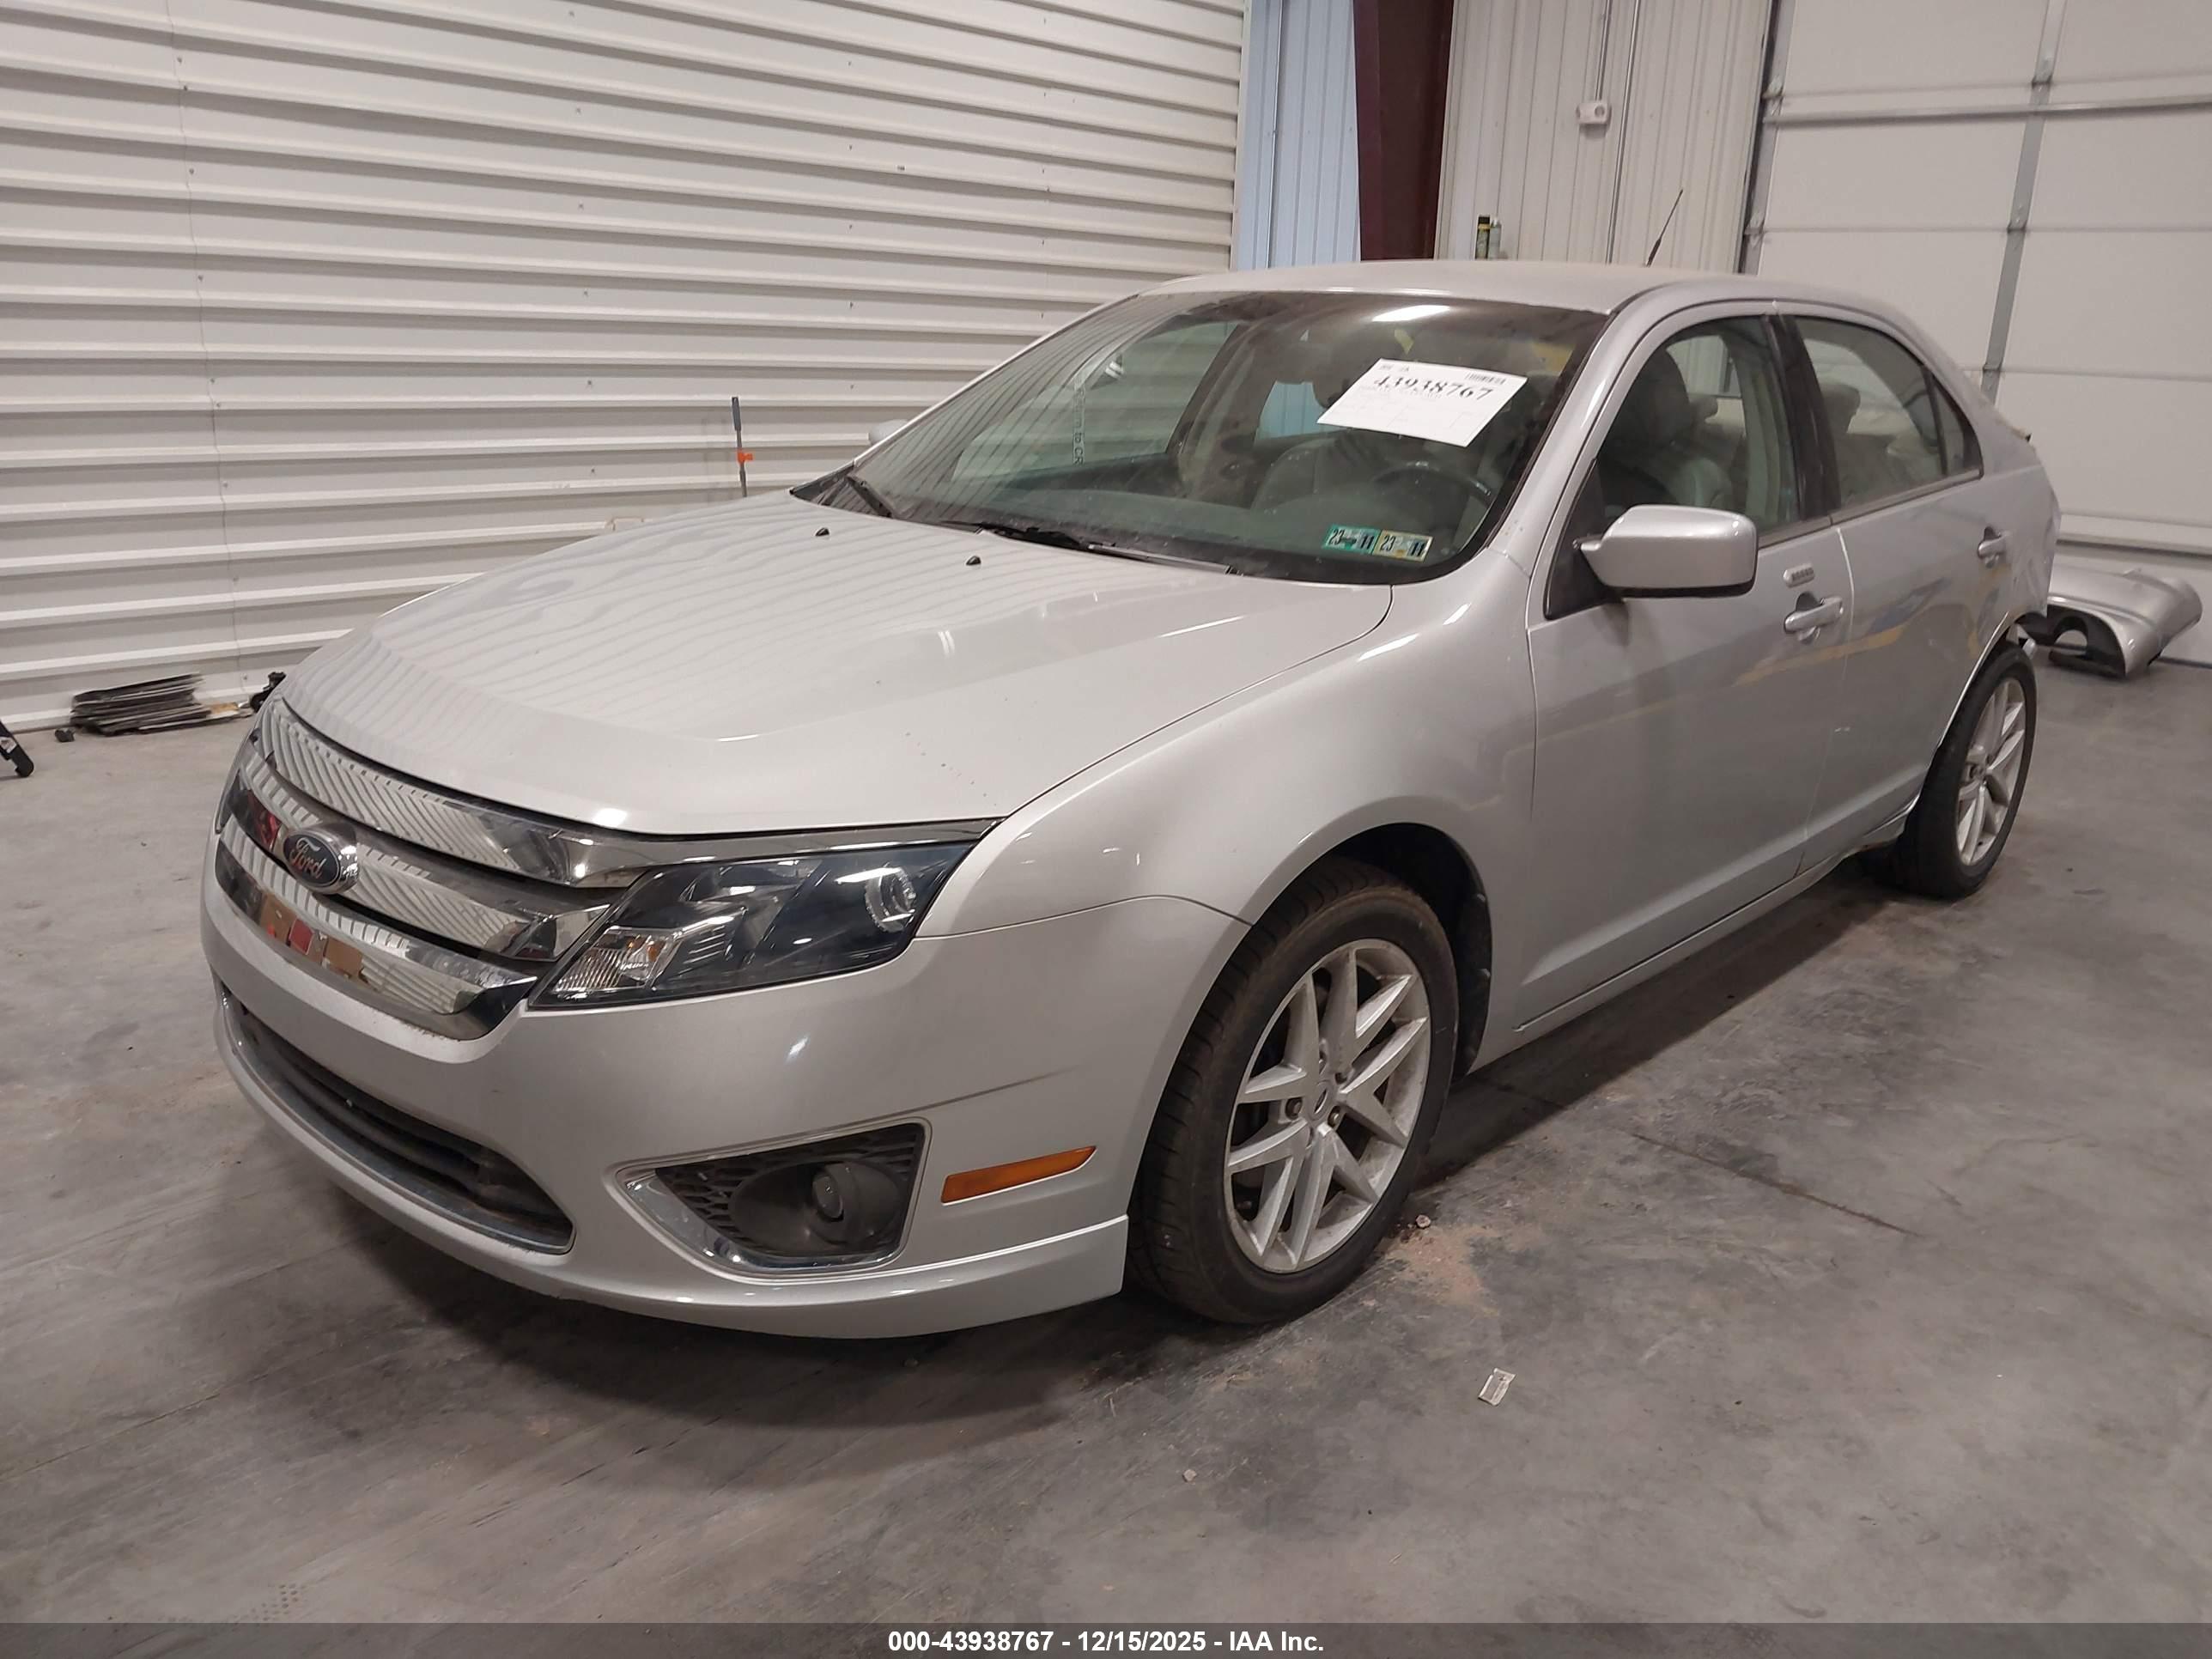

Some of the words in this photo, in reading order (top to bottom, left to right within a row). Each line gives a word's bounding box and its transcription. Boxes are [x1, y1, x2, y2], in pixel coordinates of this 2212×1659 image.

[1374, 375, 1493, 400] 43938767
[1329, 528, 1345, 545] 23
[1360, 535, 1375, 550] 11
[1379, 534, 1396, 551] 23
[1411, 541, 1426, 556] 11
[289, 838, 328, 879] Ford
